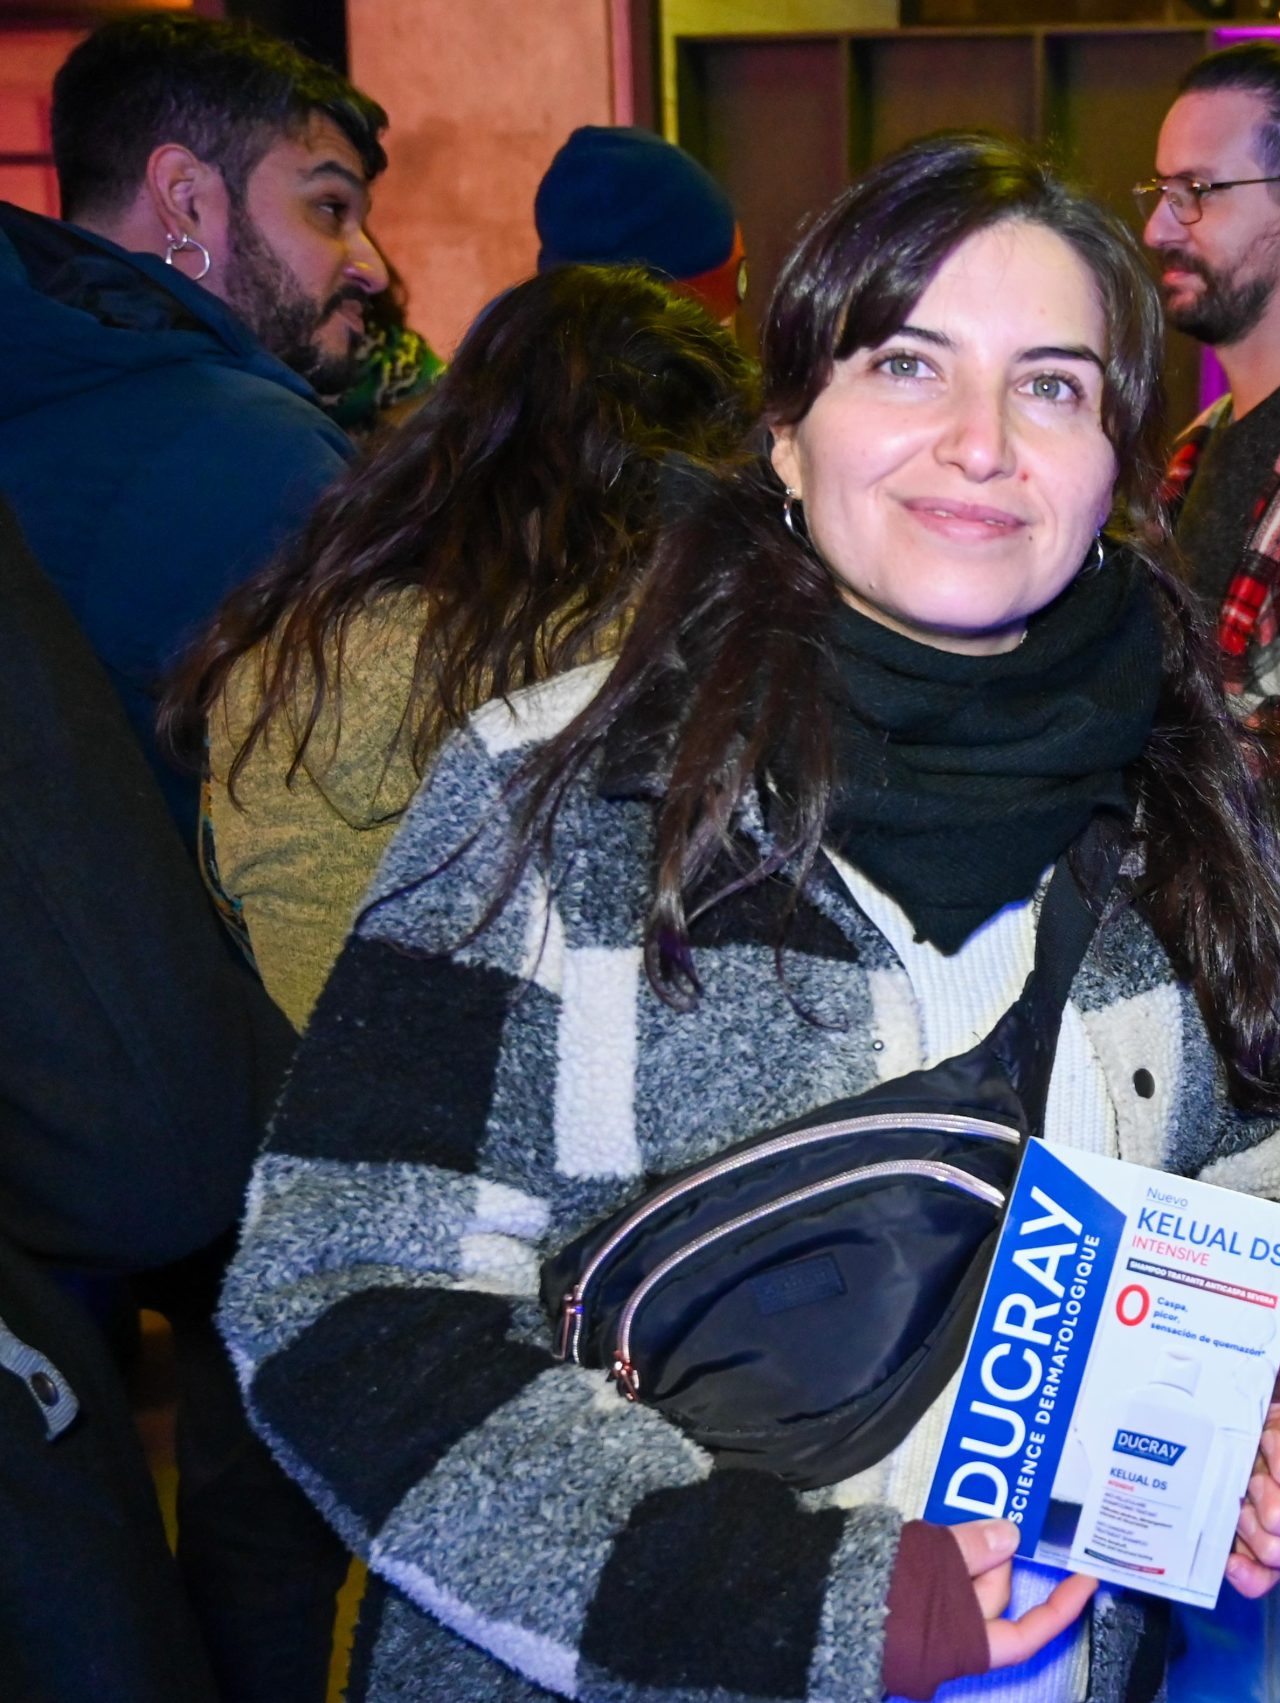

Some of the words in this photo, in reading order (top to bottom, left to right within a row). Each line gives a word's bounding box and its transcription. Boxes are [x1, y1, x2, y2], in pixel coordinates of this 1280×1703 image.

[1146, 1187, 1188, 1207] Nuevo
[1137, 1207, 1242, 1256] KELUAL
[1132, 1235, 1211, 1267] INTENSIVE
[1153, 1310, 1181, 1323] picor,
[1156, 1296, 1189, 1313] Caspa,
[1150, 1322, 1197, 1340] sensación
[1199, 1333, 1211, 1344] de
[943, 1185, 1083, 1520] DUCRAY
[1007, 1430, 1046, 1524] SCIENCE
[1033, 1233, 1101, 1426] DERMATOLOGIQUE
[1117, 1432, 1180, 1459] DUCRAY
[1109, 1466, 1150, 1487] KELUAL
[1152, 1478, 1169, 1491] DS
